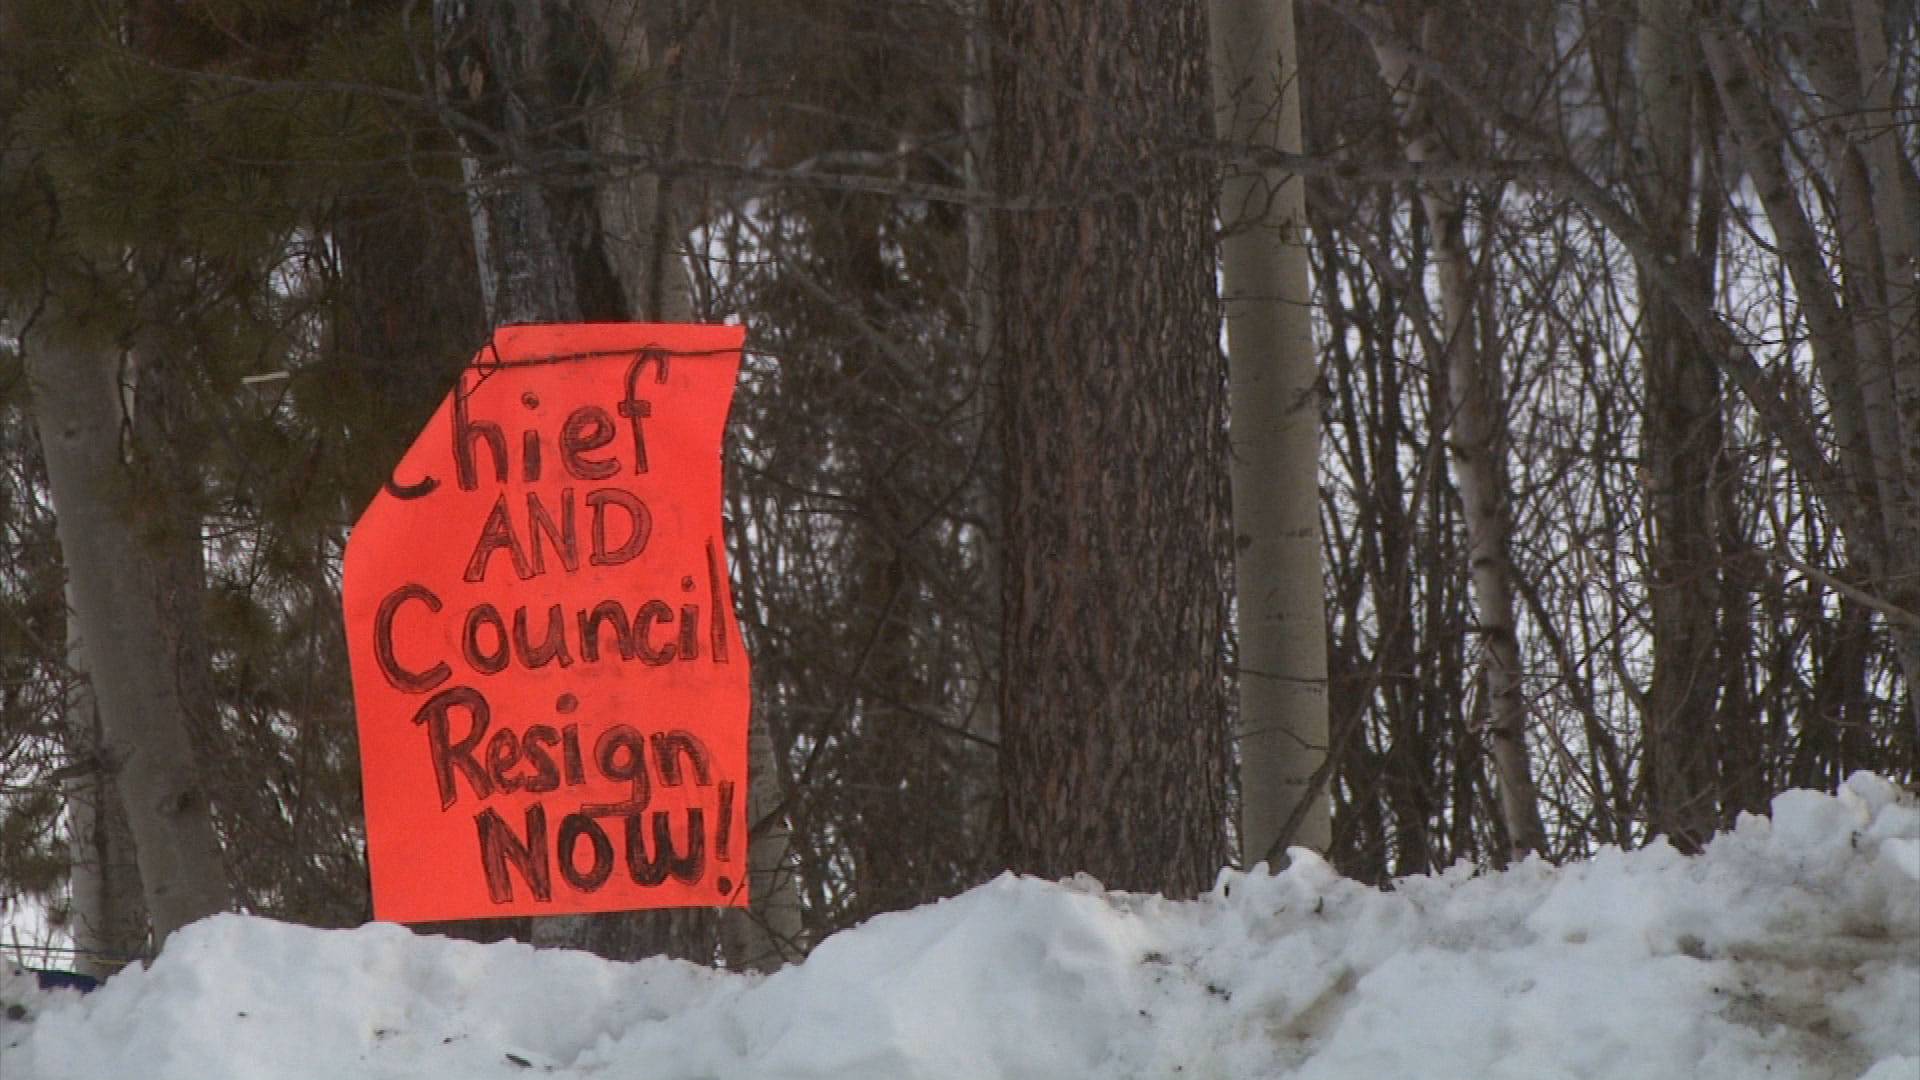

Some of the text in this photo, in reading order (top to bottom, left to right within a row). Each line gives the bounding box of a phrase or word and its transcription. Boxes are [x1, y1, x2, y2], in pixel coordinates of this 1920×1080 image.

[463, 487, 653, 583] AND
[373, 536, 730, 694] Council
[411, 685, 713, 818] Resign
[473, 780, 735, 905] NOW!
